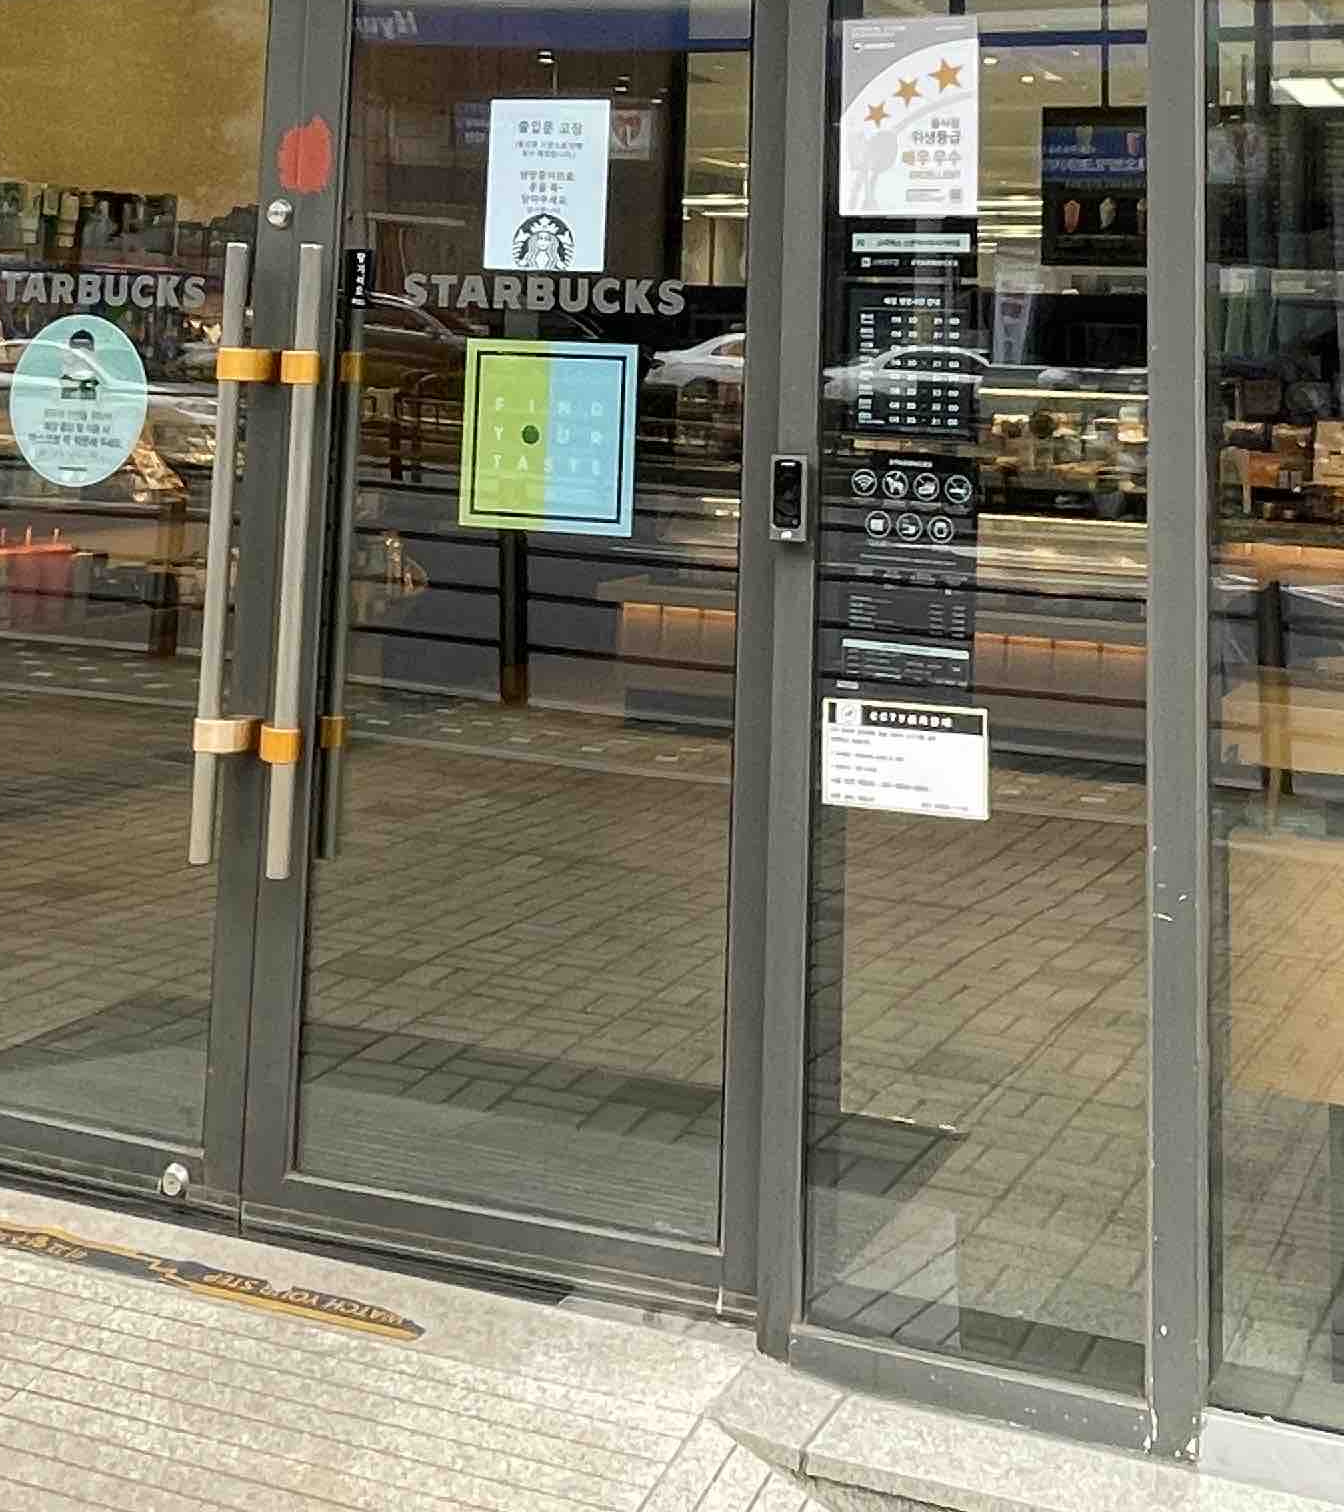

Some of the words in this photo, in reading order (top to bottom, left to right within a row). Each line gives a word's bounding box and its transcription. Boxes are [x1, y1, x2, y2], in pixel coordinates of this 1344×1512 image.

[559, 121, 583, 136] 고장
[404, 272, 688, 317] STARBUCKS
[494, 396, 604, 417] FIND
[492, 453, 603, 477] TASTE
